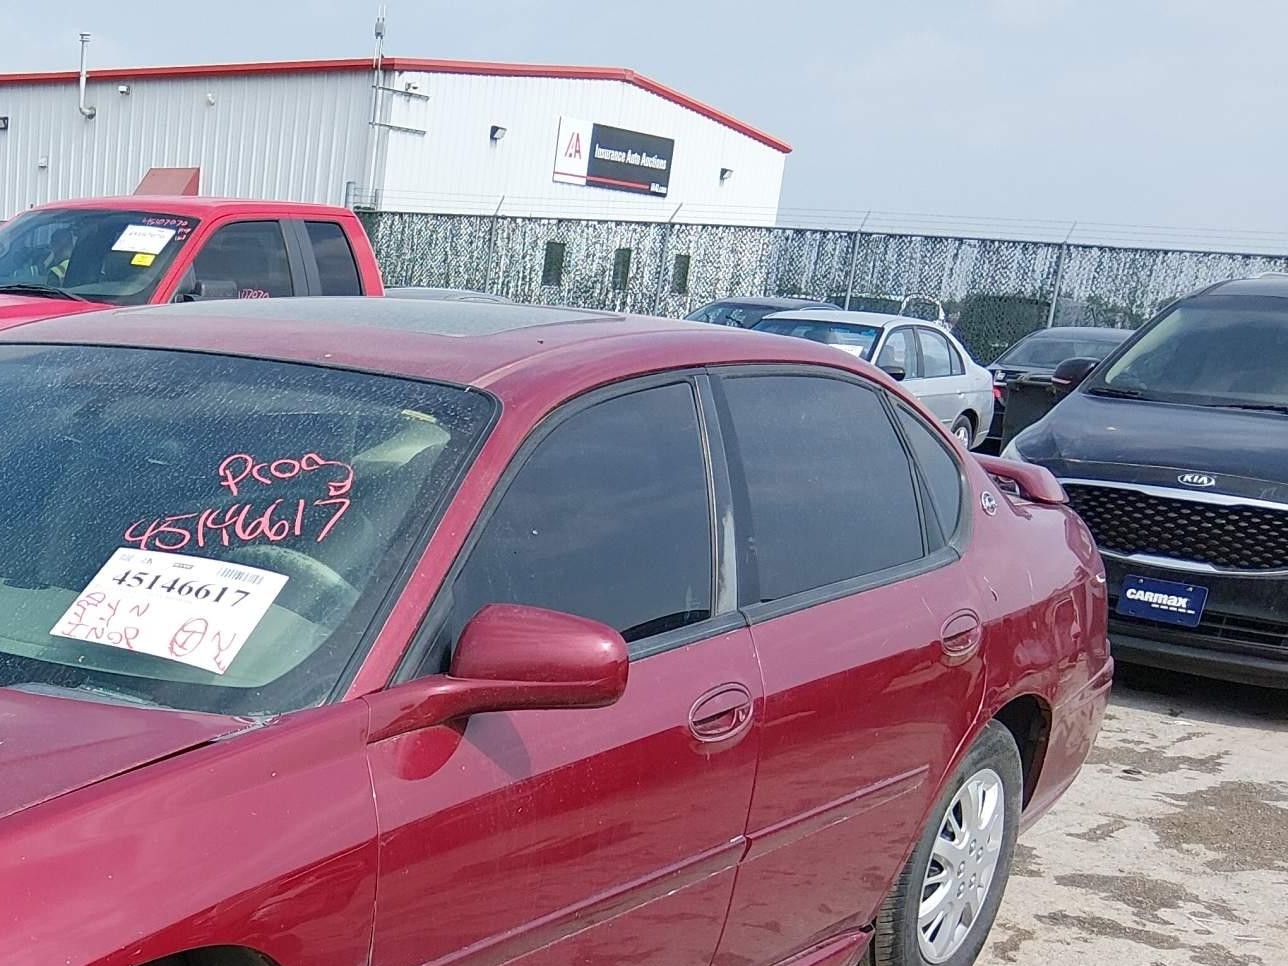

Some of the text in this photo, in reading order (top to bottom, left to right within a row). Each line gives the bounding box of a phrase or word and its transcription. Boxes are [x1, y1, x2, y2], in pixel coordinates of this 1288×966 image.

[594, 143, 668, 171] Insurance Auto Auctions
[1182, 473, 1208, 485] KIA
[124, 498, 351, 550] 45146617
[112, 569, 251, 607] 45146617
